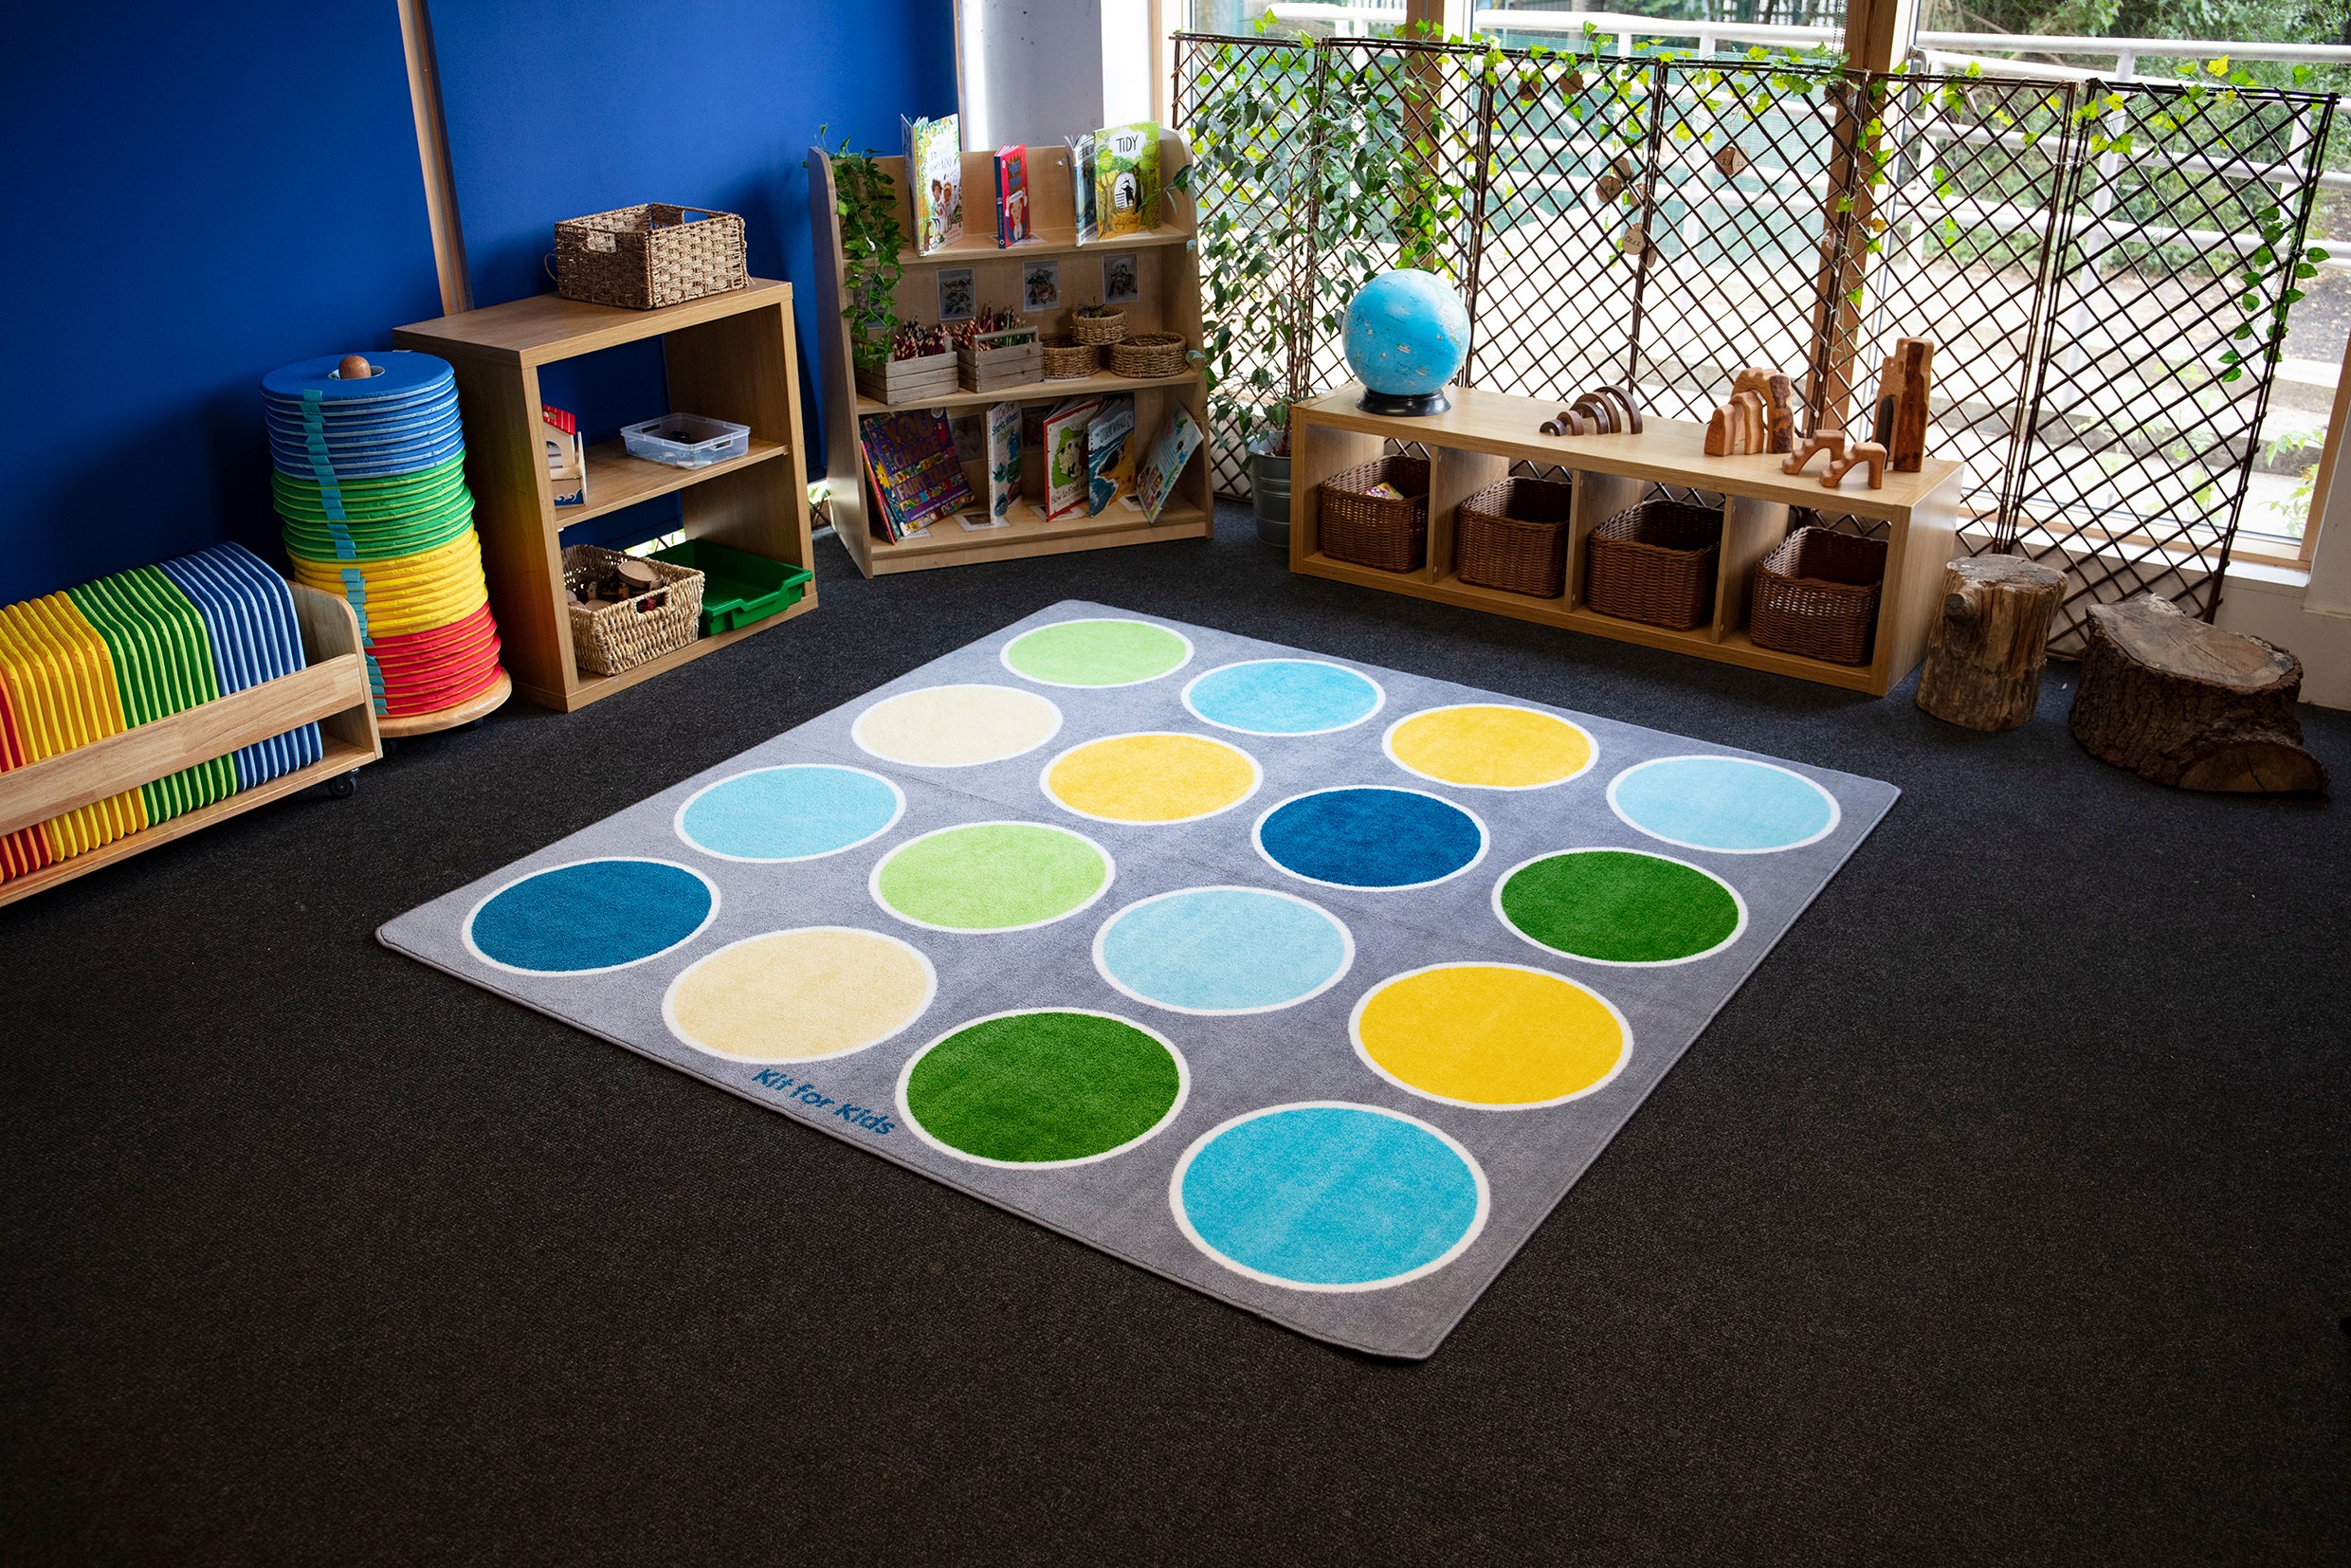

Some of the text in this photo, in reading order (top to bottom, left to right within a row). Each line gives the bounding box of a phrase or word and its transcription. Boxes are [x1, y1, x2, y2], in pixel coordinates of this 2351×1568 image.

[1116, 135, 1139, 153] TIDY
[884, 410, 933, 449] YOU
[894, 435, 940, 469] CHOOSE
[751, 1068, 896, 1136] Kit for Kids
